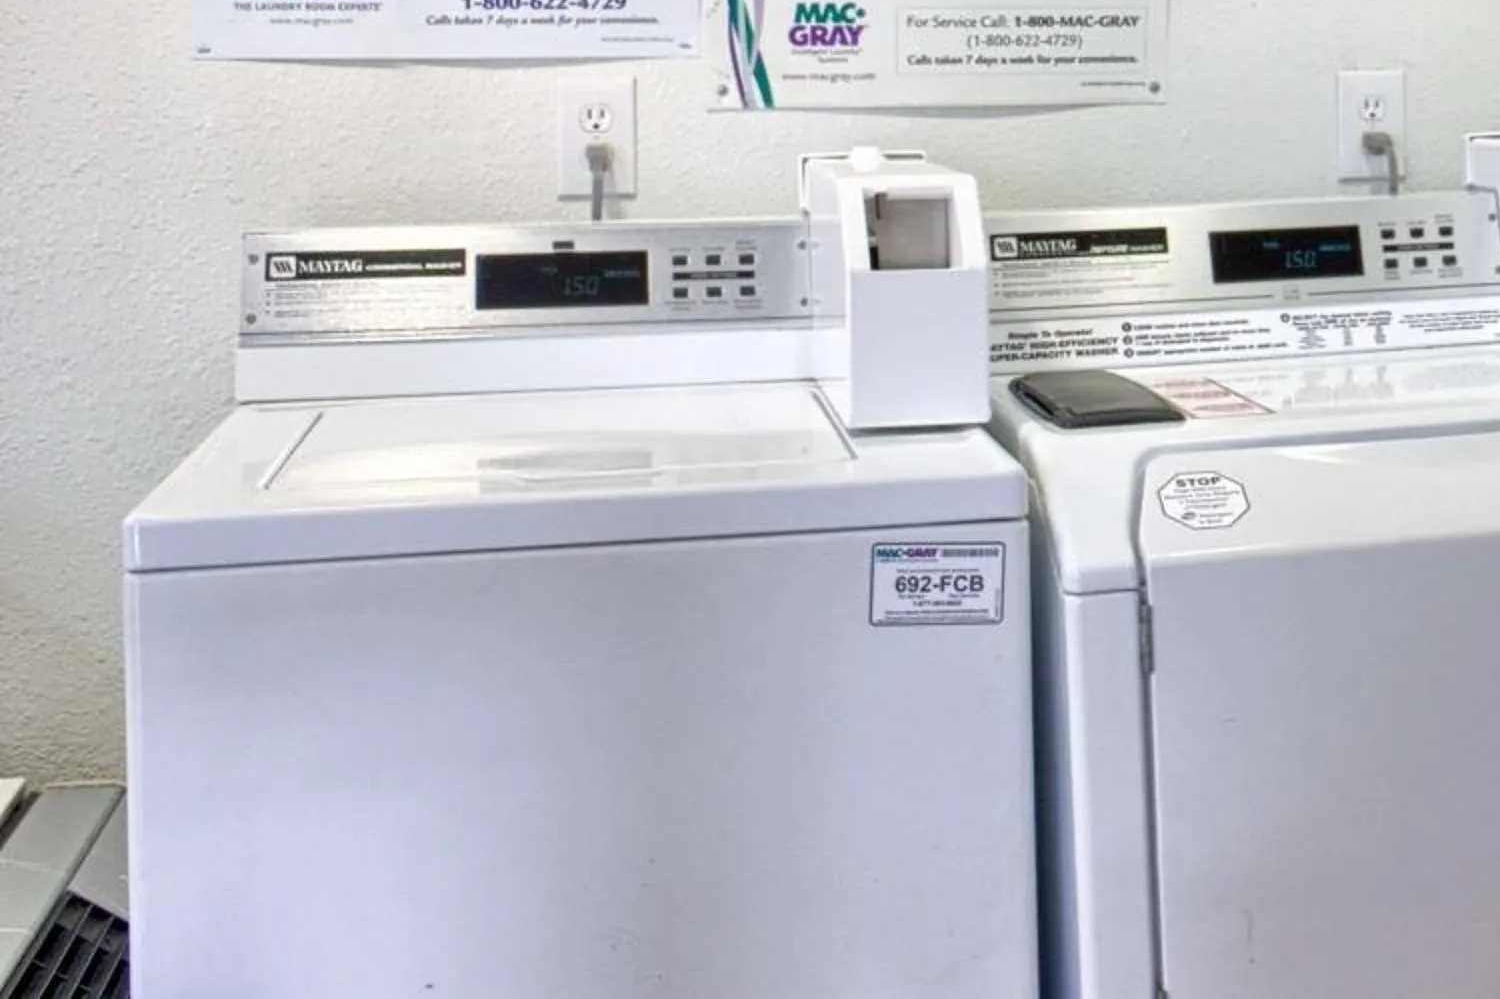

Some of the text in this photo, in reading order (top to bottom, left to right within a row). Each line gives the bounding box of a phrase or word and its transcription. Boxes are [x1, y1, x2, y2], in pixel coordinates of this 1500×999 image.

[233, 2, 381, 11] THE LAUNDRY ROOM EXPERTS
[425, 15, 452, 25] Calls
[453, 15, 483, 24] taken
[495, 15, 518, 27] days
[529, 15, 554, 24] week
[557, 15, 573, 25] for
[575, 17, 597, 26] your
[906, 16, 928, 27] For
[932, 16, 976, 27] Service
[1014, 15, 1139, 27] 1-800-MAC-GRAY
[788, 24, 863, 46] GRAY
[966, 33, 1082, 49] (1-800-622-4729)
[907, 55, 932, 64] Calls
[934, 56, 963, 64] taken
[974, 54, 998, 66] days
[1008, 55, 1034, 63] week
[1036, 55, 1051, 63] for
[1053, 56, 1076, 65] your
[1019, 238, 1077, 252] MAYTAG
[299, 259, 363, 274] MAYTAG
[1176, 476, 1220, 487] STOP
[895, 574, 984, 593] 692-FCB
